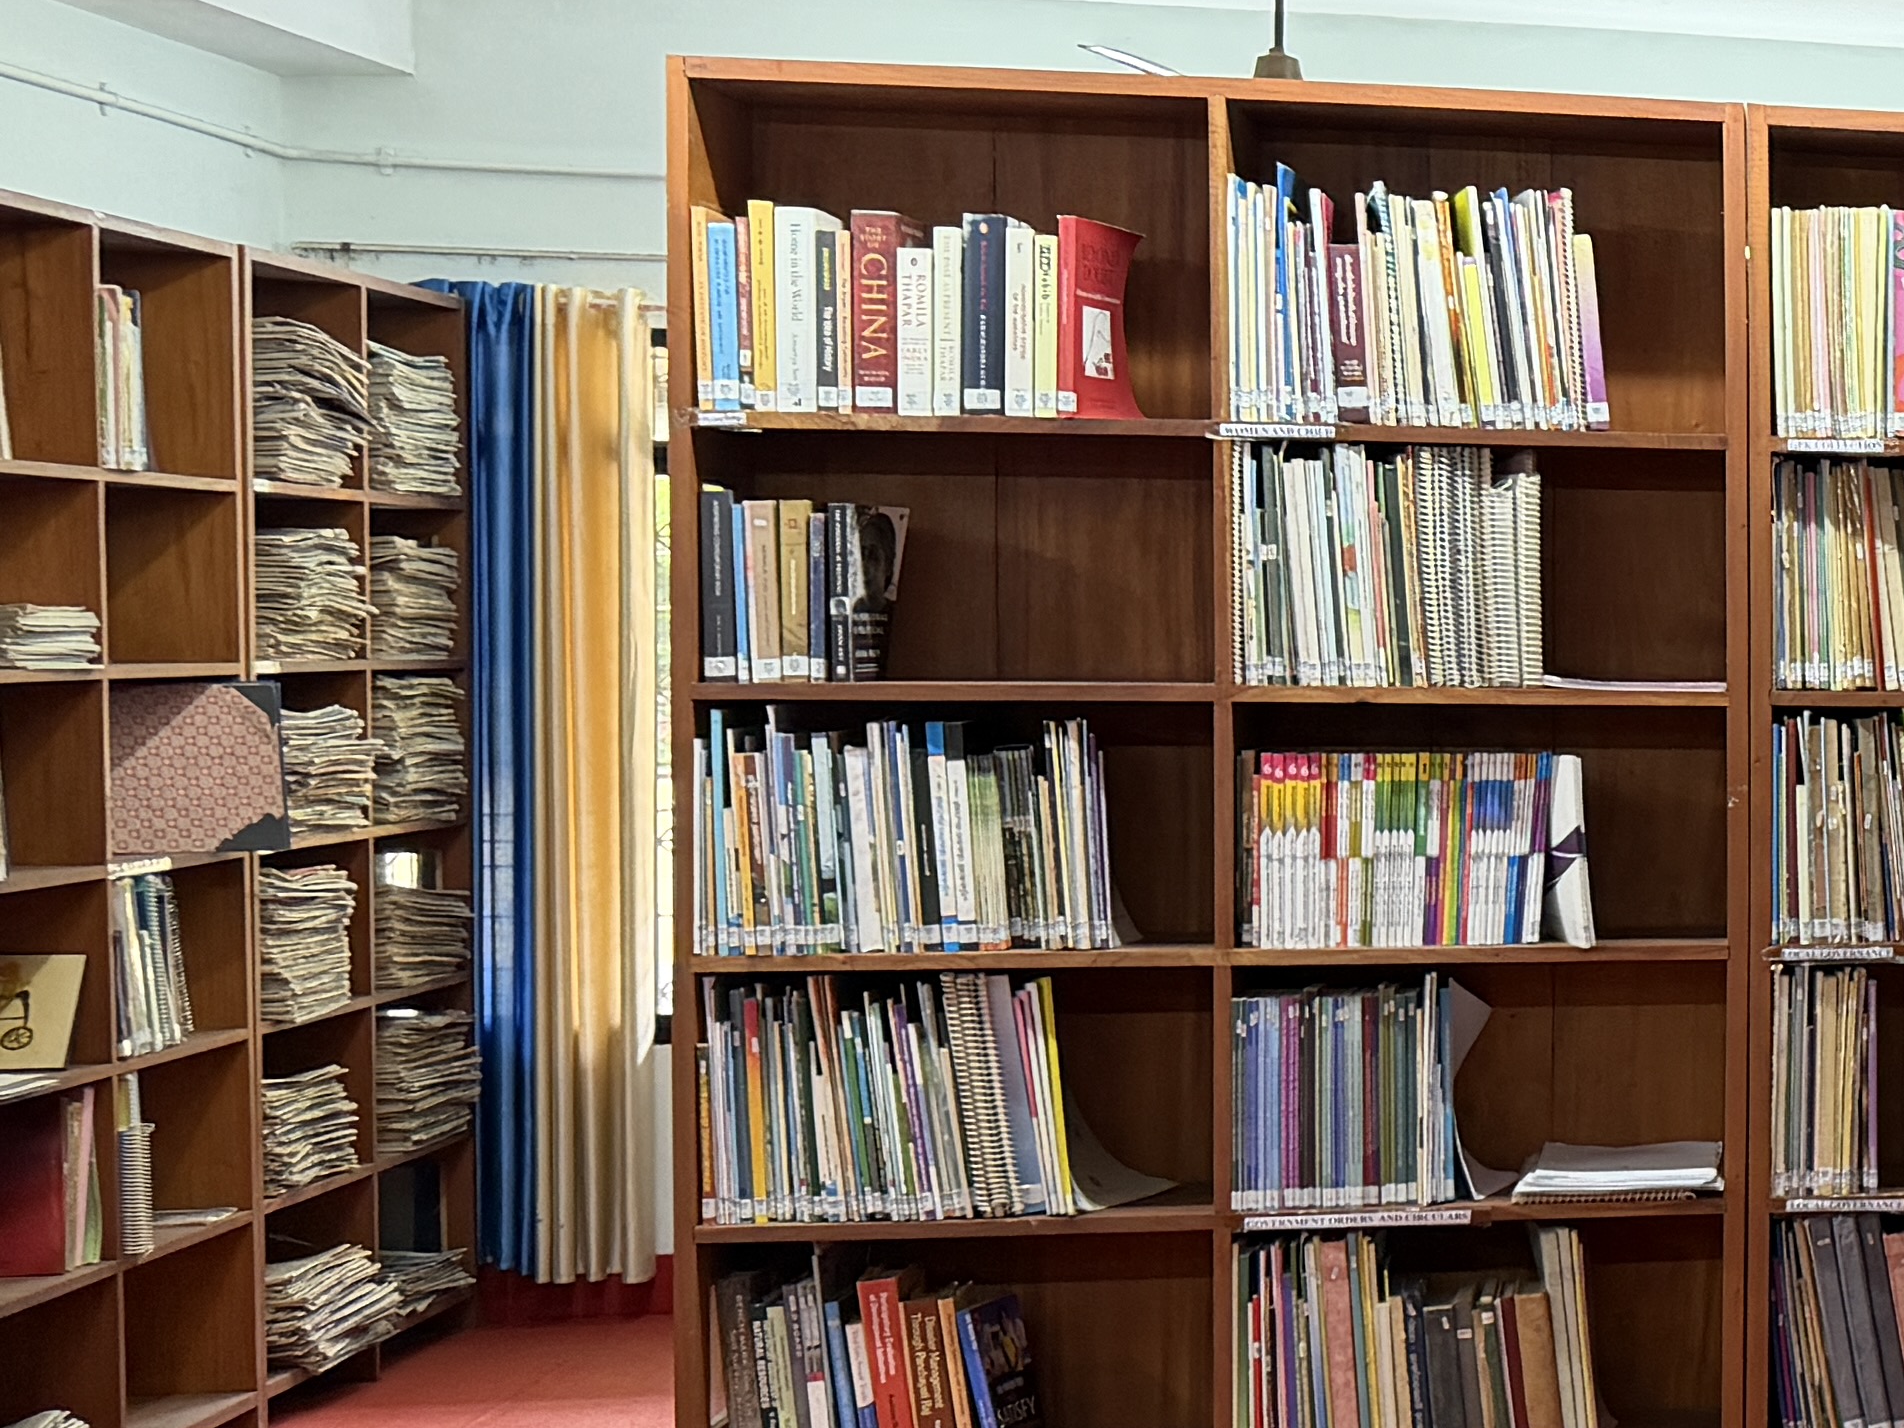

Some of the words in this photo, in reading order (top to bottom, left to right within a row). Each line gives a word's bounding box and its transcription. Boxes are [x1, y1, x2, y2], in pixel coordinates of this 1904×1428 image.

[790, 223, 800, 254] Home
[791, 258, 801, 268] in
[791, 270, 803, 287] the
[791, 290, 802, 321] World
[860, 253, 888, 359] CHINA
[901, 275, 912, 327] THAPAR
[916, 274, 927, 327] ROMILA
[822, 346, 833, 371] History
[1272, 427, 1295, 436] AND
[1829, 1200, 1902, 1209] GOVERNANCE
[1246, 1218, 1324, 1229] GOVERNMENT
[1328, 1215, 1375, 1226] ORDERS
[1379, 1214, 1402, 1223] AND
[752, 1321, 766, 1359] NATURAL
[755, 1362, 771, 1410] RESOURCES
[928, 1353, 944, 1409] Management
